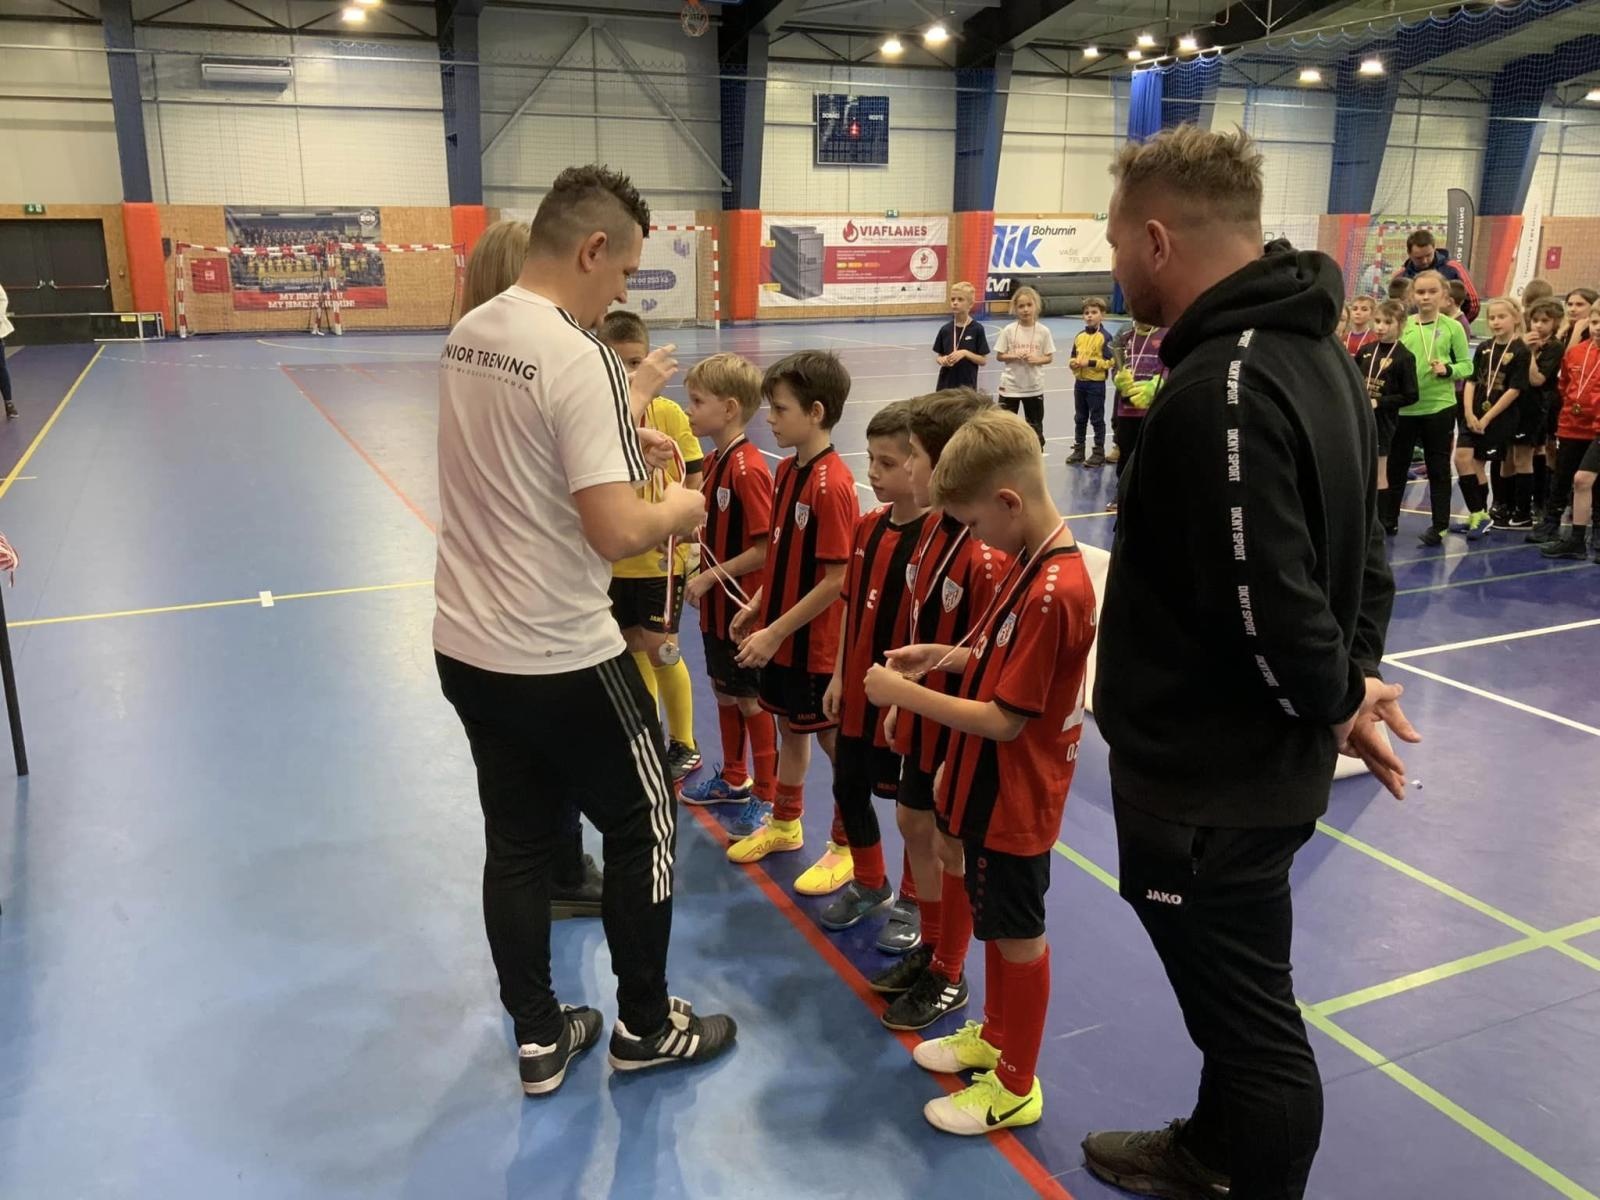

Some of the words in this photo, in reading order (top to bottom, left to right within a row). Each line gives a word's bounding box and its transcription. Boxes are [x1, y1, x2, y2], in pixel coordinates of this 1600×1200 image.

[860, 225, 928, 236] VIAFLAMES
[477, 350, 538, 381] TRENING
[1228, 360, 1242, 380] DKNY
[1227, 380, 1239, 405] SPORT
[1227, 428, 1239, 453] DKNY
[1228, 453, 1241, 482] SPORT
[1231, 506, 1243, 531] DKNY
[1233, 532, 1246, 561] SPORT
[1237, 585, 1251, 610] DKNY
[1242, 610, 1257, 636] SPORT
[1146, 889, 1182, 904] JAKO
